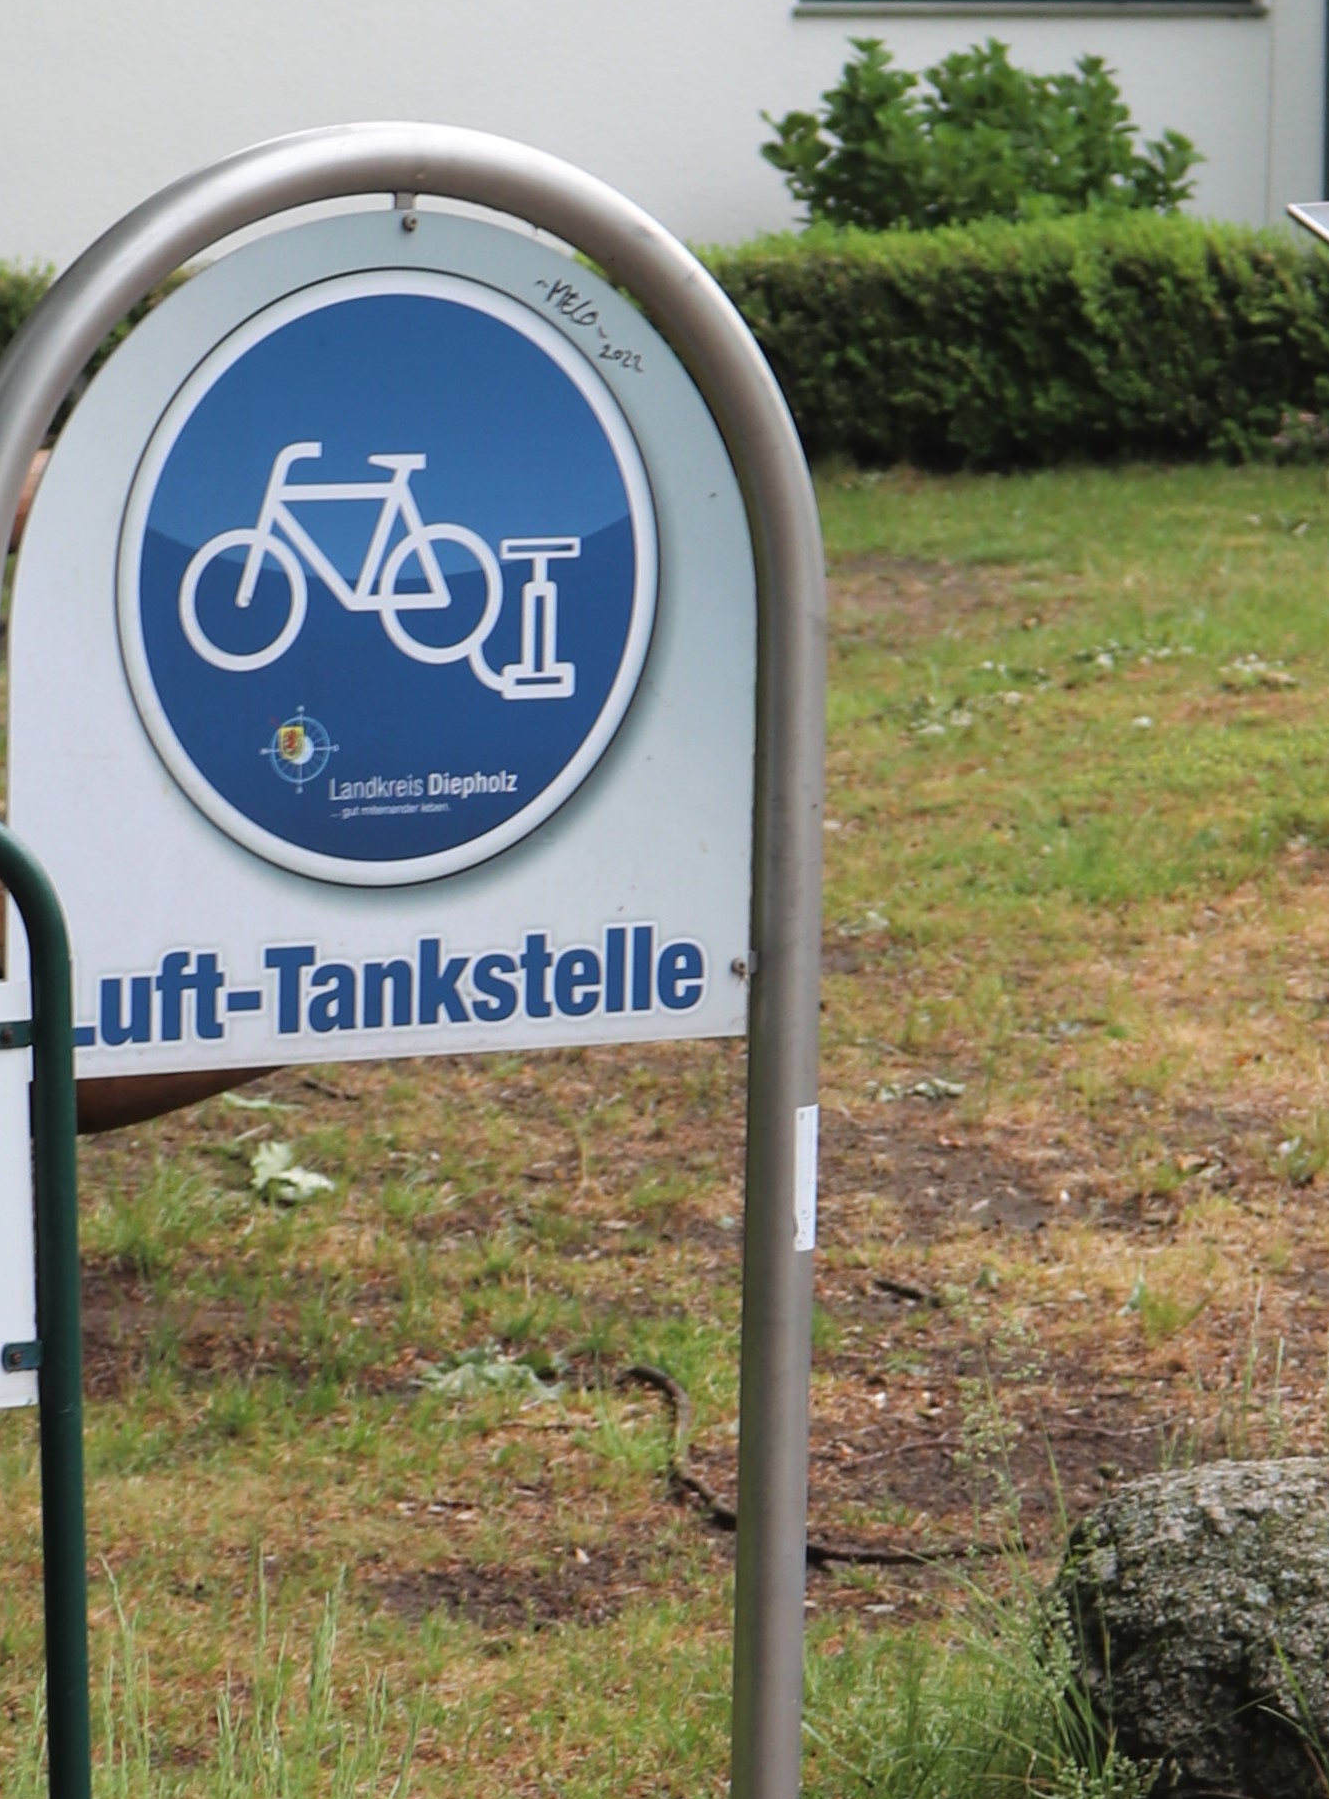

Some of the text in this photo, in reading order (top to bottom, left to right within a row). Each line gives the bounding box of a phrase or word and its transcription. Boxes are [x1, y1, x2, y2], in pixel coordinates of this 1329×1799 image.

[329, 770, 518, 801] Landkreis Diepholz
[73, 925, 704, 1048] uft-Tankstelle
